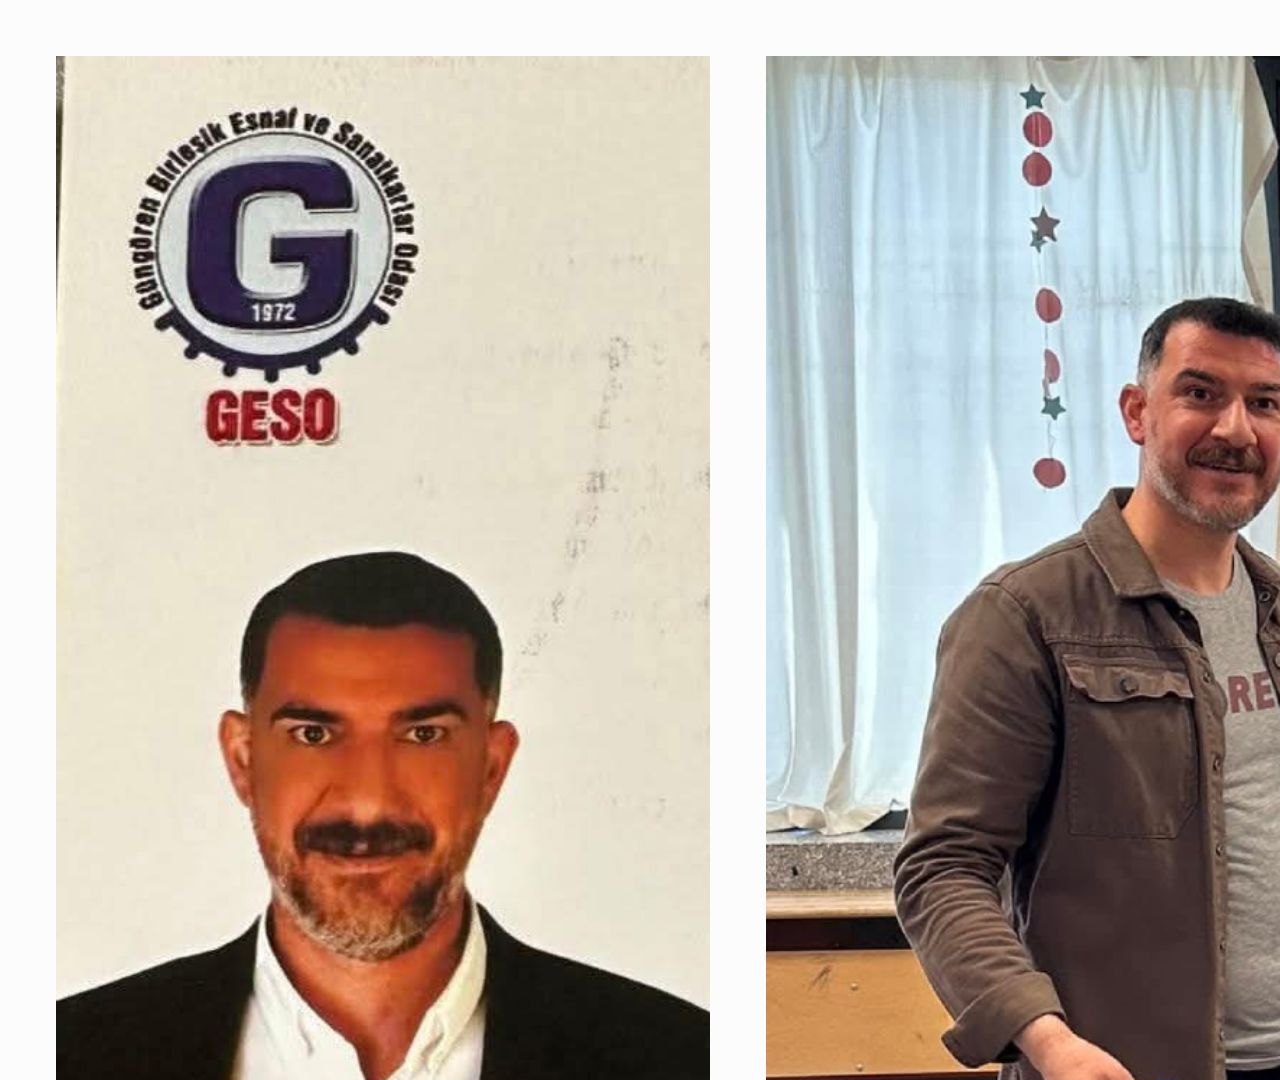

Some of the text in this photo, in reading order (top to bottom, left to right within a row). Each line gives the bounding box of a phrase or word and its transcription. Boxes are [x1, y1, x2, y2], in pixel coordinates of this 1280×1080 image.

[228, 107, 297, 135] Esnaf
[304, 113, 330, 135] ve
[251, 302, 296, 322] 1972
[206, 388, 338, 444] GESO
